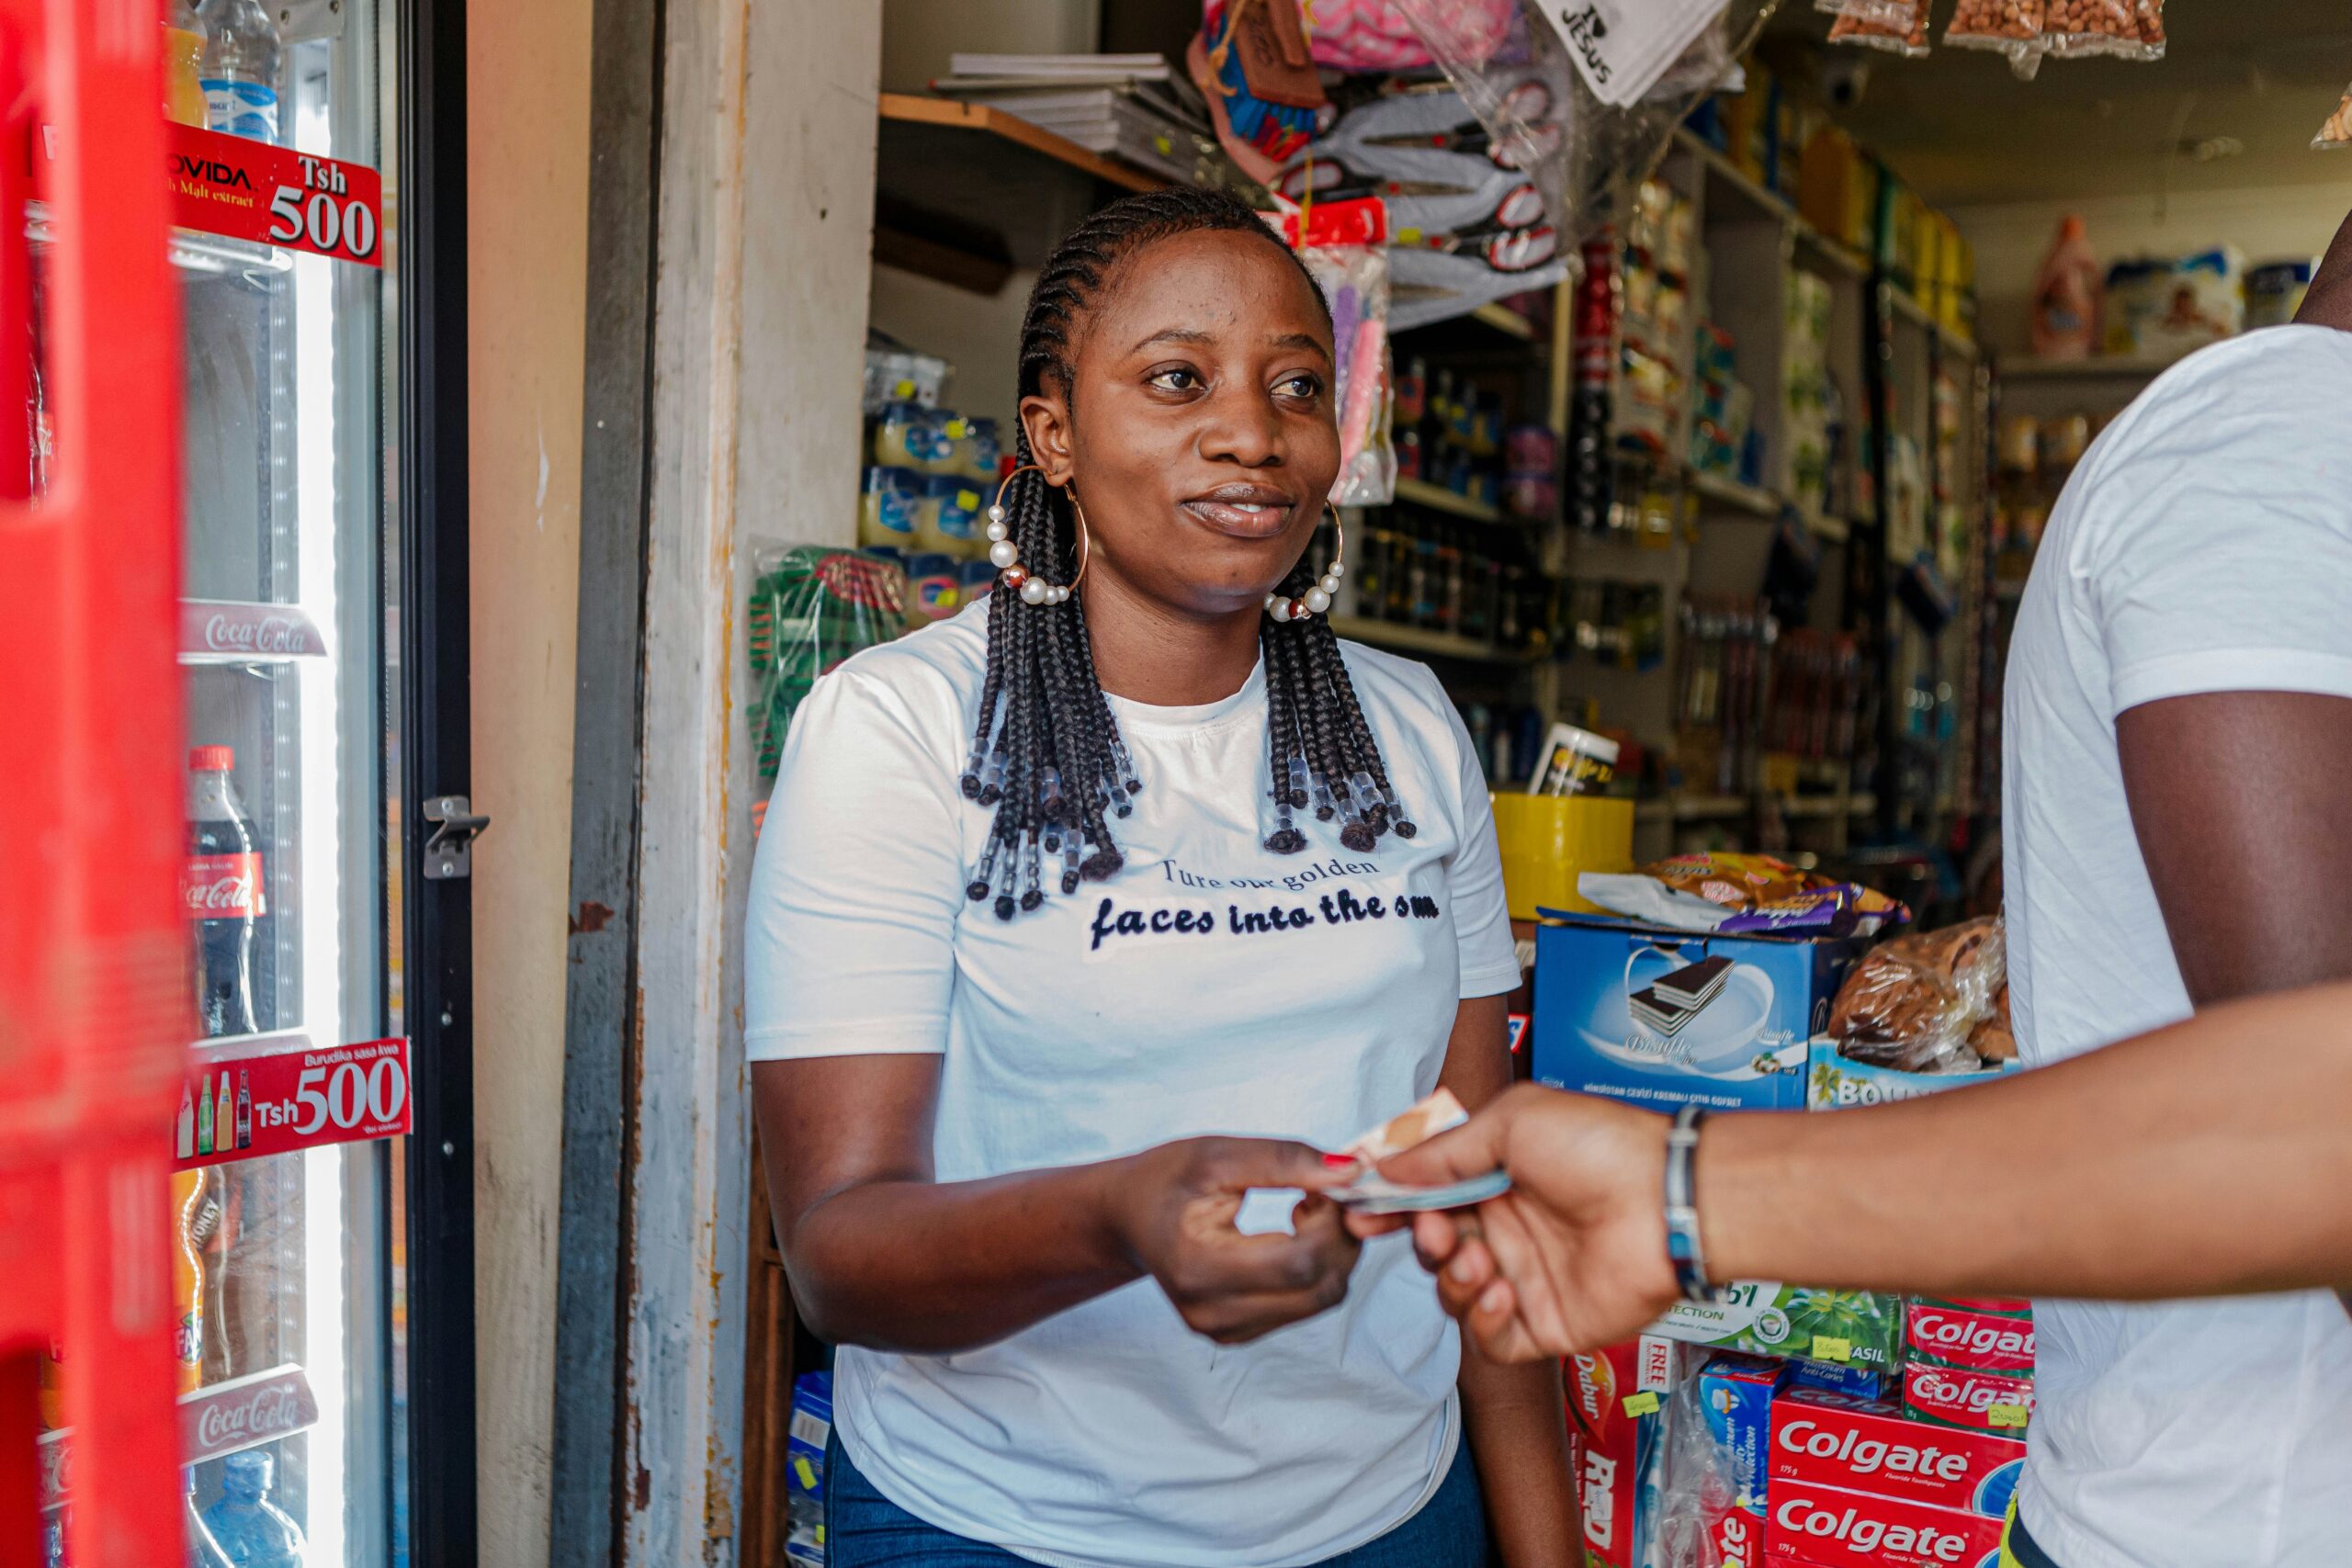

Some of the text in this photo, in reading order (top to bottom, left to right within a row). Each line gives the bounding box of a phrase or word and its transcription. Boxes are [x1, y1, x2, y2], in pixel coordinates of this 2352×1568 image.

[1582, 3, 1596, 22] I
[1562, 8, 1612, 85] JESUS
[169, 153, 252, 190] OVIDA
[299, 155, 347, 195] Tsh
[181, 180, 254, 209] Malt extract
[269, 185, 376, 257] 500
[206, 614, 305, 651] Coca-Cola
[1230, 879, 1275, 888] our
[1283, 858, 1381, 891] golden
[1091, 897, 1215, 950] faces
[1228, 904, 1315, 934] into
[1318, 887, 1386, 924] the
[305, 1050, 352, 1066] Burudika
[354, 1047, 377, 1060] sasa
[378, 1043, 399, 1056] kwa
[254, 1056, 405, 1135] Tsh 500
[1669, 1304, 1724, 1321] TECTION
[1915, 1315, 2035, 1354] Colgat
[1652, 1343, 1668, 1385] FREE
[1574, 1353, 1600, 1420] Dabur
[1912, 1374, 2036, 1413] Colga
[198, 1385, 298, 1448] Coca-Cola
[1778, 1420, 1969, 1482] Colgate
[1884, 1472, 1946, 1488] Fluoride Toothpaste
[1776, 1499, 1967, 1562] Colgate
[1882, 1551, 1909, 1562] Fluoride
